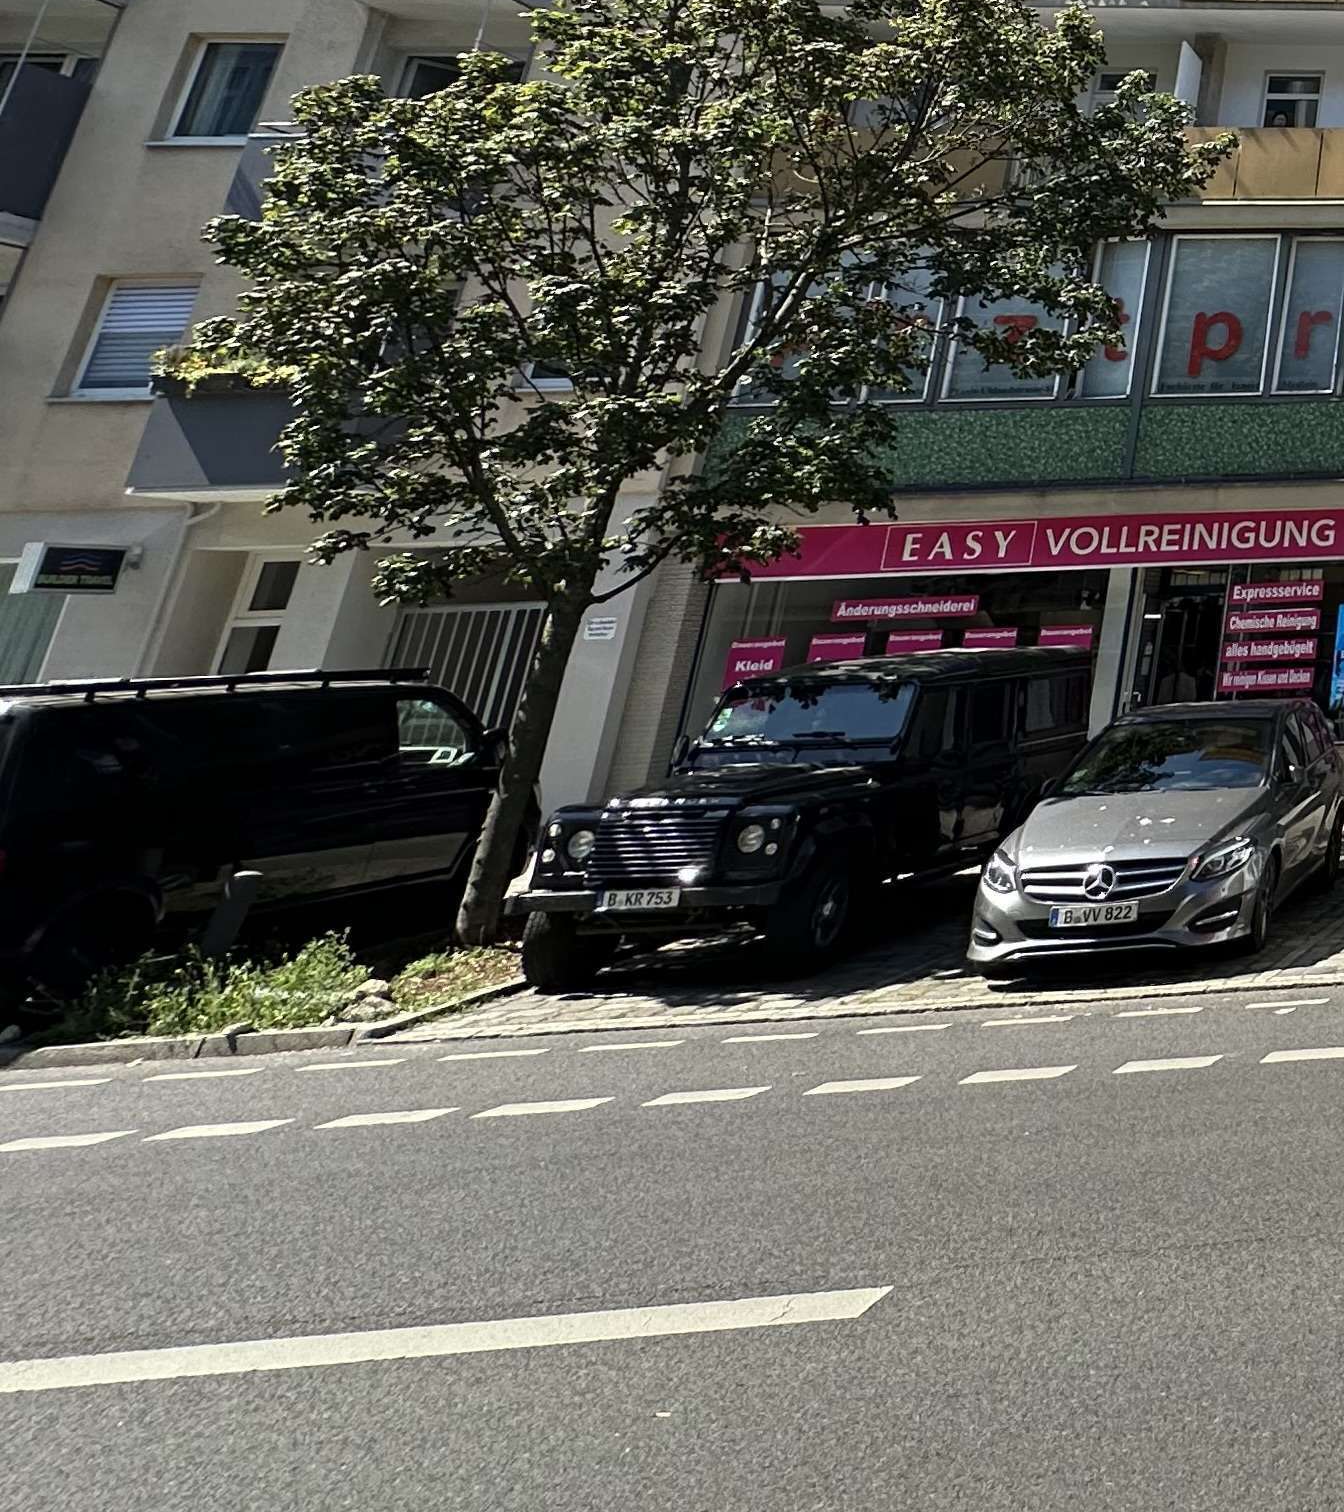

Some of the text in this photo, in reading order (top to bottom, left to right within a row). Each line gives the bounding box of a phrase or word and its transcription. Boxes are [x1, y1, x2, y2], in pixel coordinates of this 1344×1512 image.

[901, 519, 1336, 561] EASY VOLLREINIGUNG
[1232, 583, 1320, 602] Expressservice
[836, 598, 976, 618] Änderungsschneiderei
[1229, 614, 1317, 630] Chemische Reinigung
[1226, 640, 1314, 659] alles handgebügelt
[735, 659, 774, 672] Kleid
[608, 891, 673, 906] B KR 753
[1064, 906, 1132, 924] B VV 822
